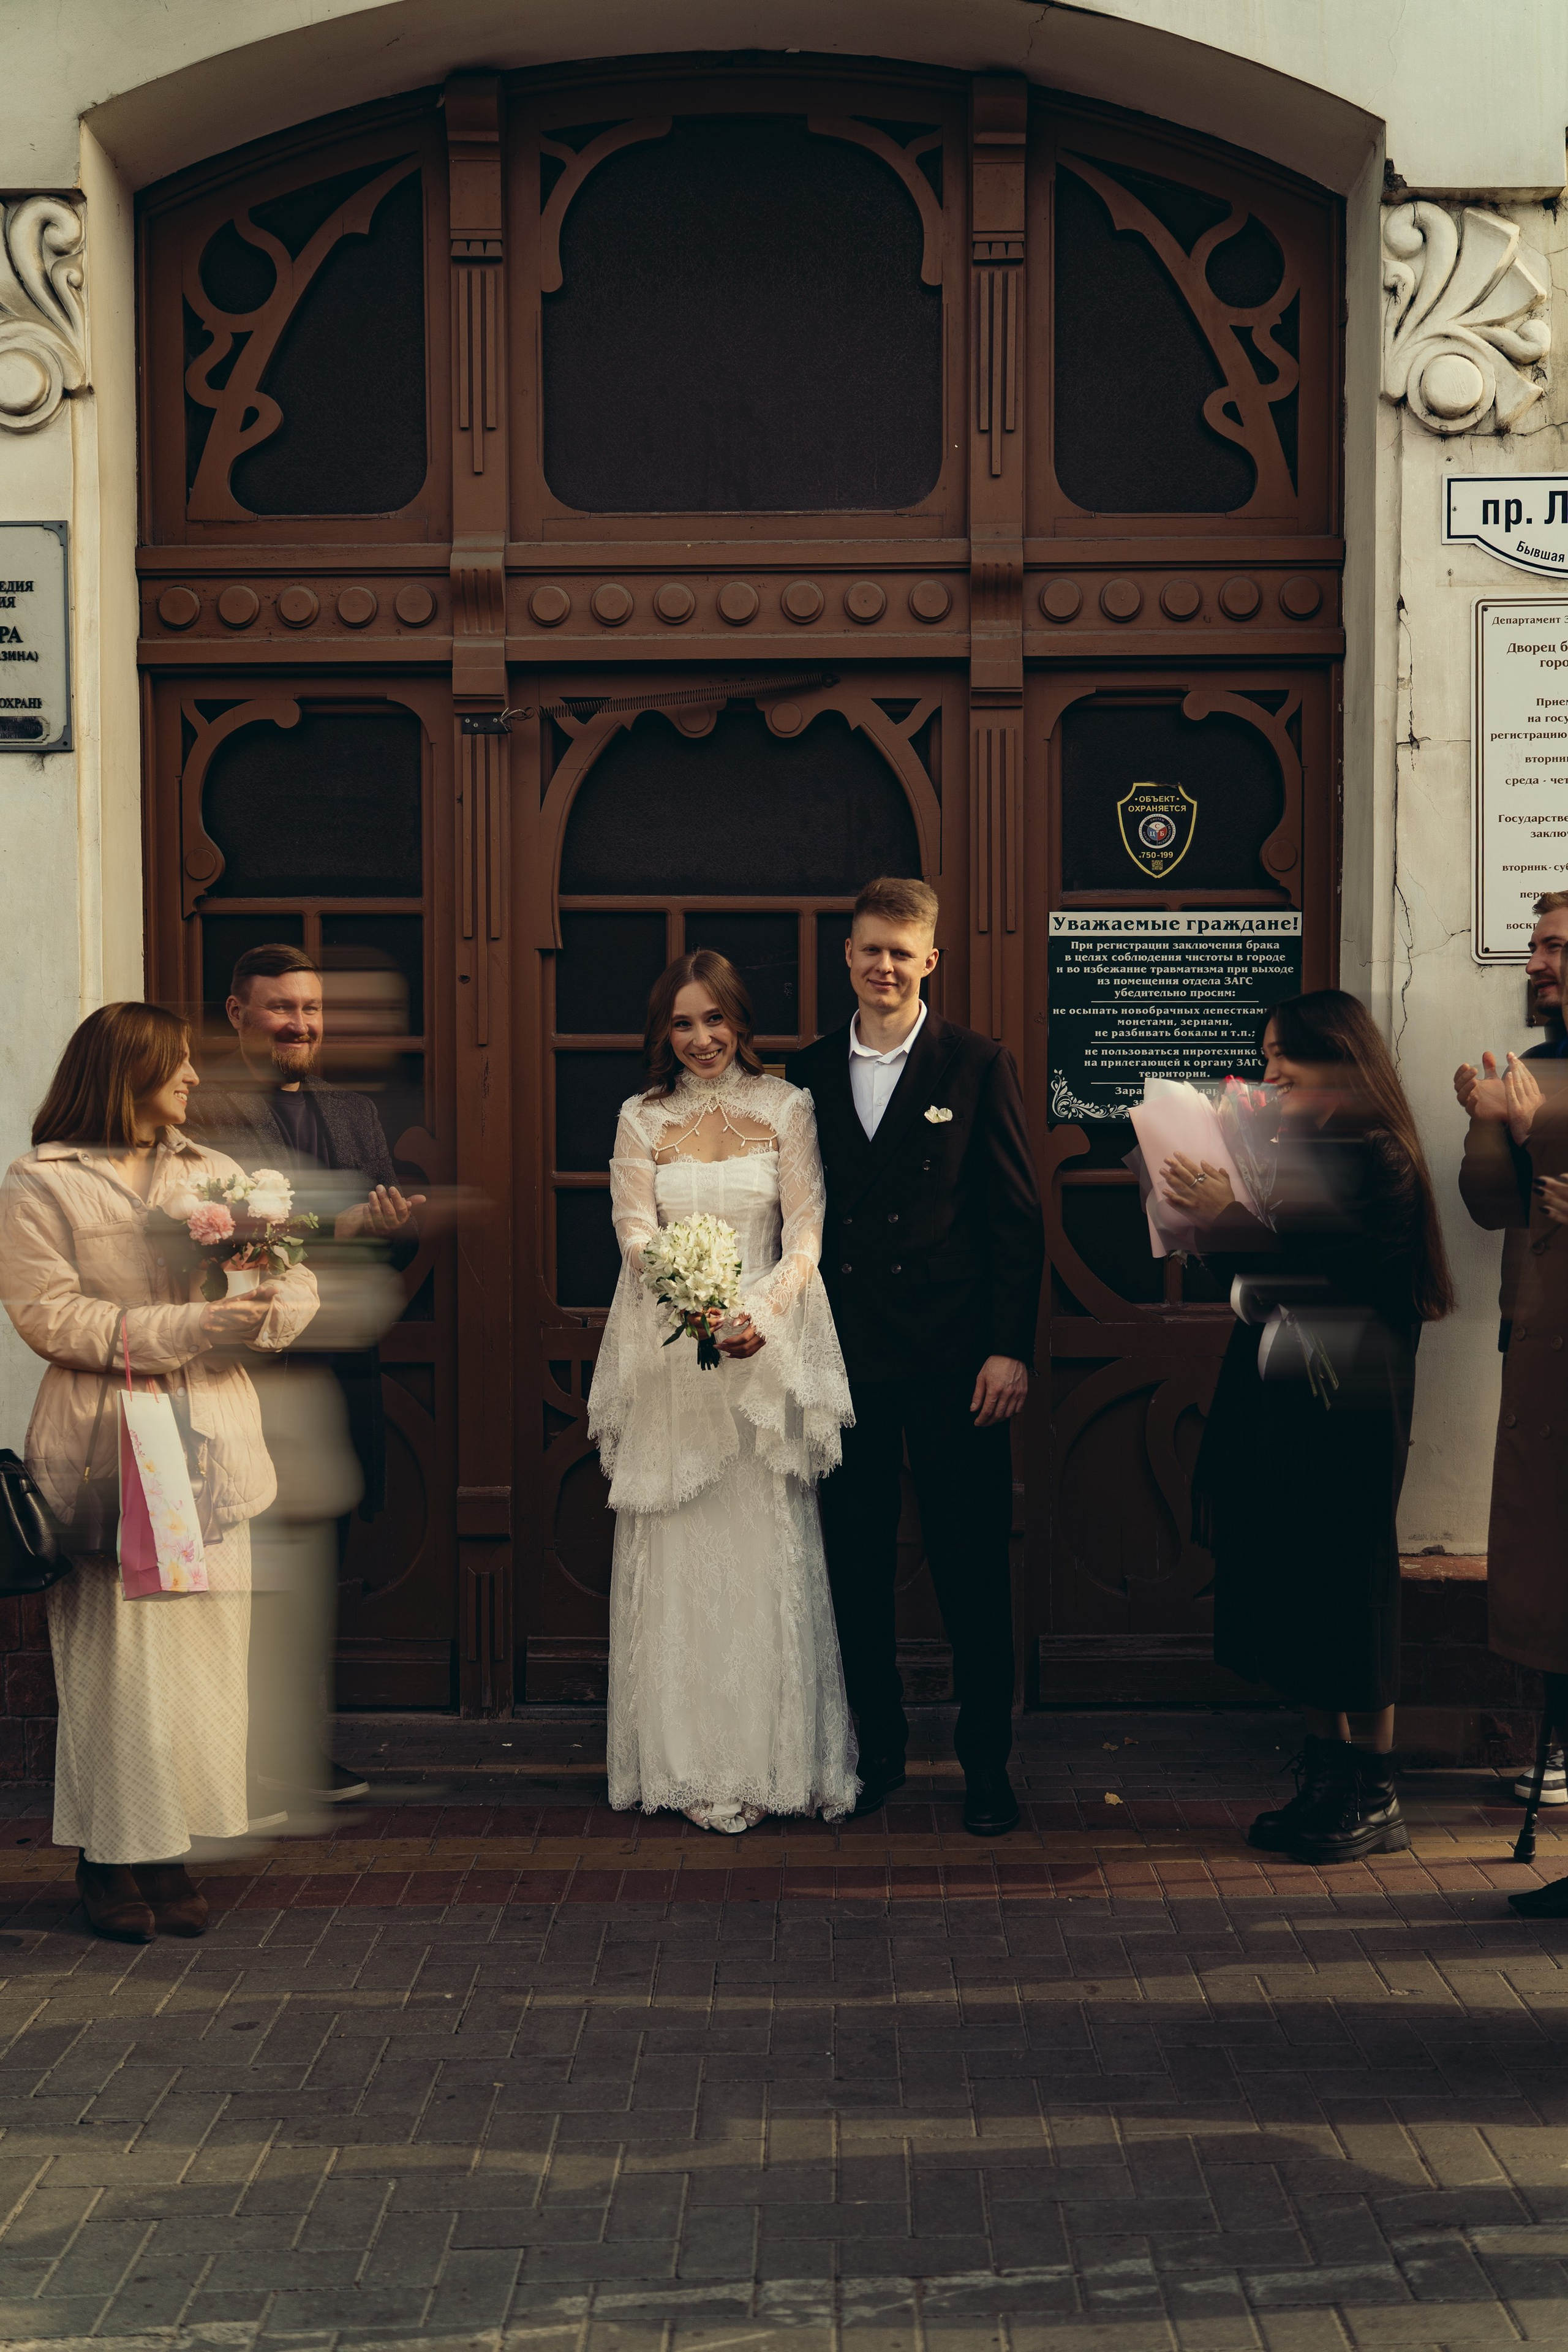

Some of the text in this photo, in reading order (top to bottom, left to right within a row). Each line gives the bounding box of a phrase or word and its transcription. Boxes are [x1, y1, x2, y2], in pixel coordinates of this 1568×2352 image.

[1482, 499, 1532, 533] пр.
[1516, 540, 1565, 563] Бывшая
[1491, 616, 1561, 627] Департамент
[1506, 642, 1556, 655] Дворец
[0, 650, 39, 662] ЗИНА)
[1540, 659, 1568, 670] горо
[1536, 698, 1568, 708] Прие
[1490, 732, 1567, 742] регистрацию
[1525, 756, 1568, 765] вторни
[1505, 778, 1539, 787] среда
[1052, 916, 1298, 935] Уважаемые граждане!
[1071, 941, 1093, 951] При
[1096, 943, 1169, 951] регистрации
[1246, 940, 1280, 951] брака
[1074, 954, 1109, 963] целях
[1111, 952, 1182, 963] соблюдения
[1246, 954, 1286, 963] городе
[1084, 963, 1147, 974] избежание
[1150, 967, 1224, 975] травматизма
[1227, 967, 1248, 975] при
[1113, 978, 1179, 987] помещения
[1182, 978, 1221, 987] отдела
[1224, 976, 1253, 985] ЗАГС
[1114, 987, 1236, 999] убедительно просим:
[1121, 1005, 1200, 1017] новобрачных
[1117, 1019, 1233, 1028] монетами, зернами,
[1111, 1027, 1171, 1039] разбивать
[1174, 1027, 1218, 1037] бокалы
[1100, 1058, 1180, 1069] прилегающей
[1193, 1060, 1234, 1069] органу
[1138, 1071, 1210, 1080] территории.
[1115, 1087, 1144, 1096] Зара
